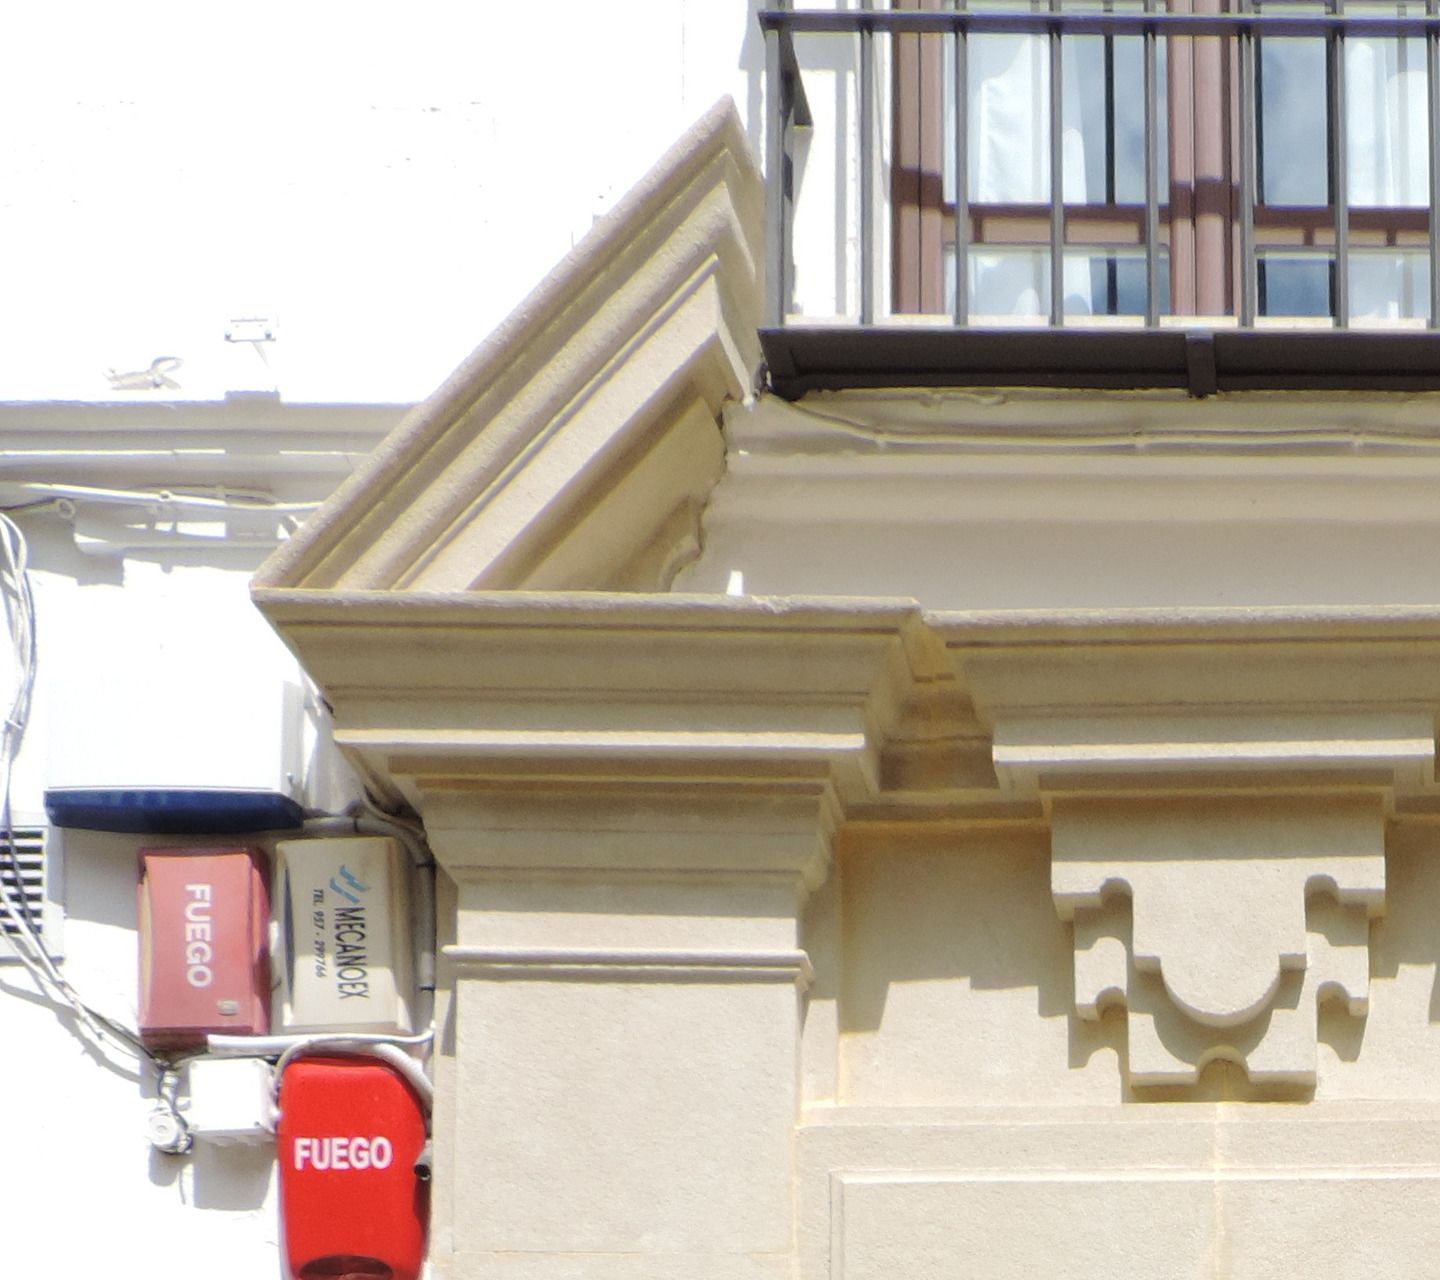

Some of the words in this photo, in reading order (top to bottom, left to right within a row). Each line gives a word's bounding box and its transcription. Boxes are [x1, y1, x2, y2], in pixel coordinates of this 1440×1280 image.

[185, 883, 213, 988] FUEGO
[335, 906, 370, 1000] MECANOEX
[294, 1136, 393, 1170] FUEGO
